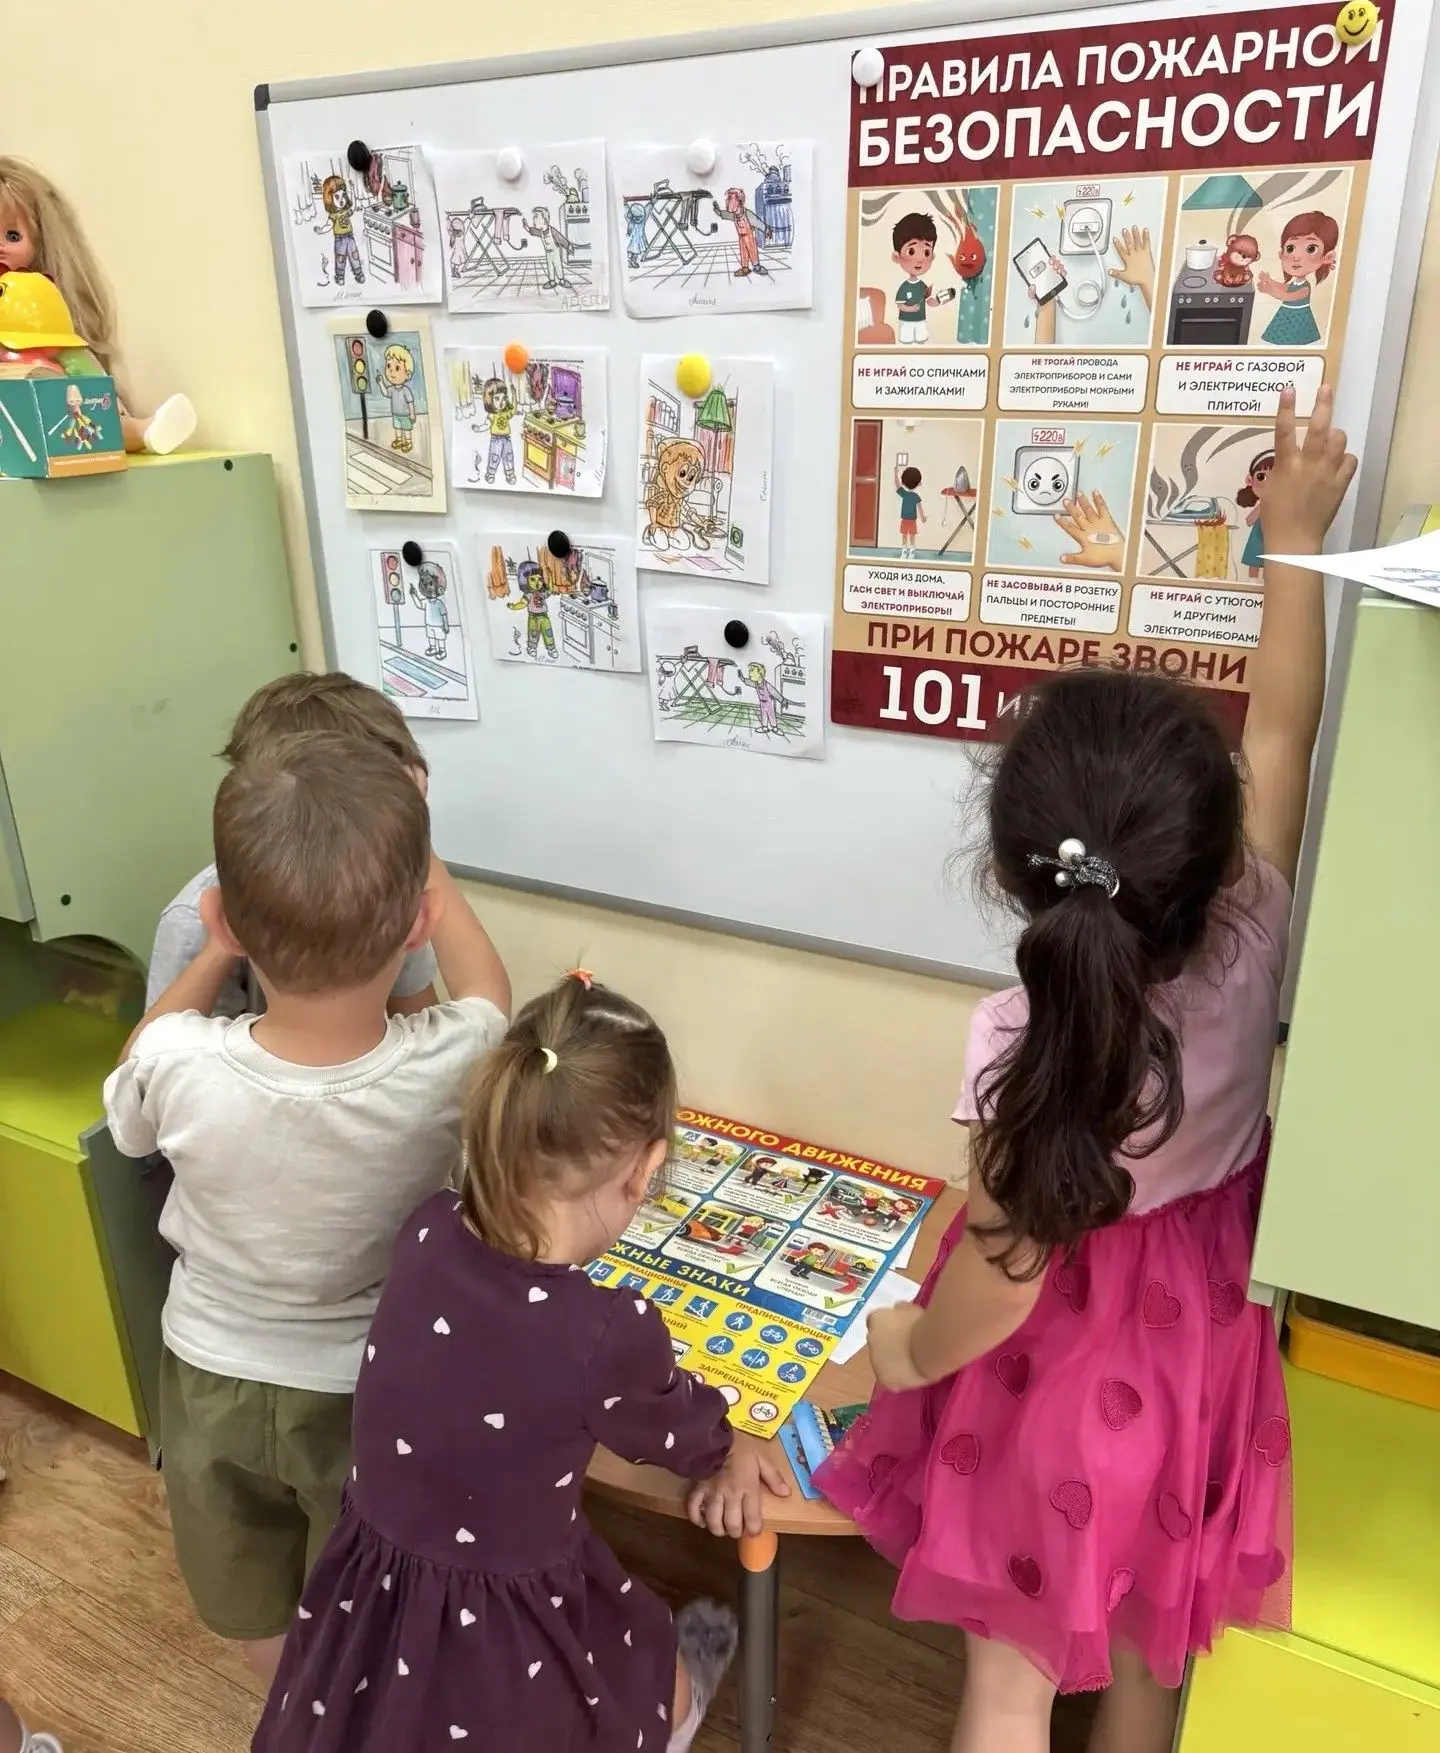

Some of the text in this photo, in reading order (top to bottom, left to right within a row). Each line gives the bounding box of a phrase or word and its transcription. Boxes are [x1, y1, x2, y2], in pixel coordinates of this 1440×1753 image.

[858, 81, 1375, 167] БЕЗОПАСНОСТИ
[1031, 357, 1118, 367] НЕ ТРОГАЙ ПРОВОДА
[1176, 359, 1305, 373] НЕ ИГРАЙ С ГАЗОВОЙ
[858, 366, 986, 378] НЕ ИГРАЙ СО СПИЧКАМИ
[1014, 372, 1133, 381] ЭЛЕКТРОПРИБОРОВ И САМИ
[875, 386, 965, 397] И ЗАЖИГАЛКАМИ!
[1009, 386, 1135, 395] ЭЛЕКТРОПРИБОРЫ МОКРЫМИ
[1178, 381, 1187, 391] И
[1052, 400, 1089, 409] РУКАМИ!
[1207, 399, 1261, 412] ПЛИТОЙ!
[868, 571, 899, 581] УХОДЯ
[901, 573, 913, 582] ИЗ
[849, 585, 965, 601] ГАСИ СВЕТ И ВЫКЛЮЧАЙ
[987, 580, 1119, 597] НЕ ЗАСОВЫВАЙ В РОЗЕТКУ
[986, 595, 1116, 613] ПАЛЬЦЫ И ПОСТОРОННИЕ
[1150, 591, 1263, 608] НЕ ИГРАЙ С УТЮГОМ
[861, 601, 953, 616] ЭЛЕКТРОПРИБОРЫ!
[1020, 613, 1076, 626] ПРЕДМЕТЫ!
[1173, 610, 1237, 624] И ДРУГИМИ
[868, 622, 1248, 684] ПРИ ПОЖАРЕ ЗВОНИ
[879, 665, 987, 730] 101
[675, 1110, 928, 1192] ОЖНОГО ДВИЖЕНИЯ
[612, 1241, 673, 1270] ЖНЫЕ
[677, 1265, 751, 1297] ЗНАКИ
[735, 1301, 833, 1342] ПРЕДПИСЫВАЮЩИЕ
[698, 1363, 780, 1401] ЗАПРЕЩАЮЩИЕ
